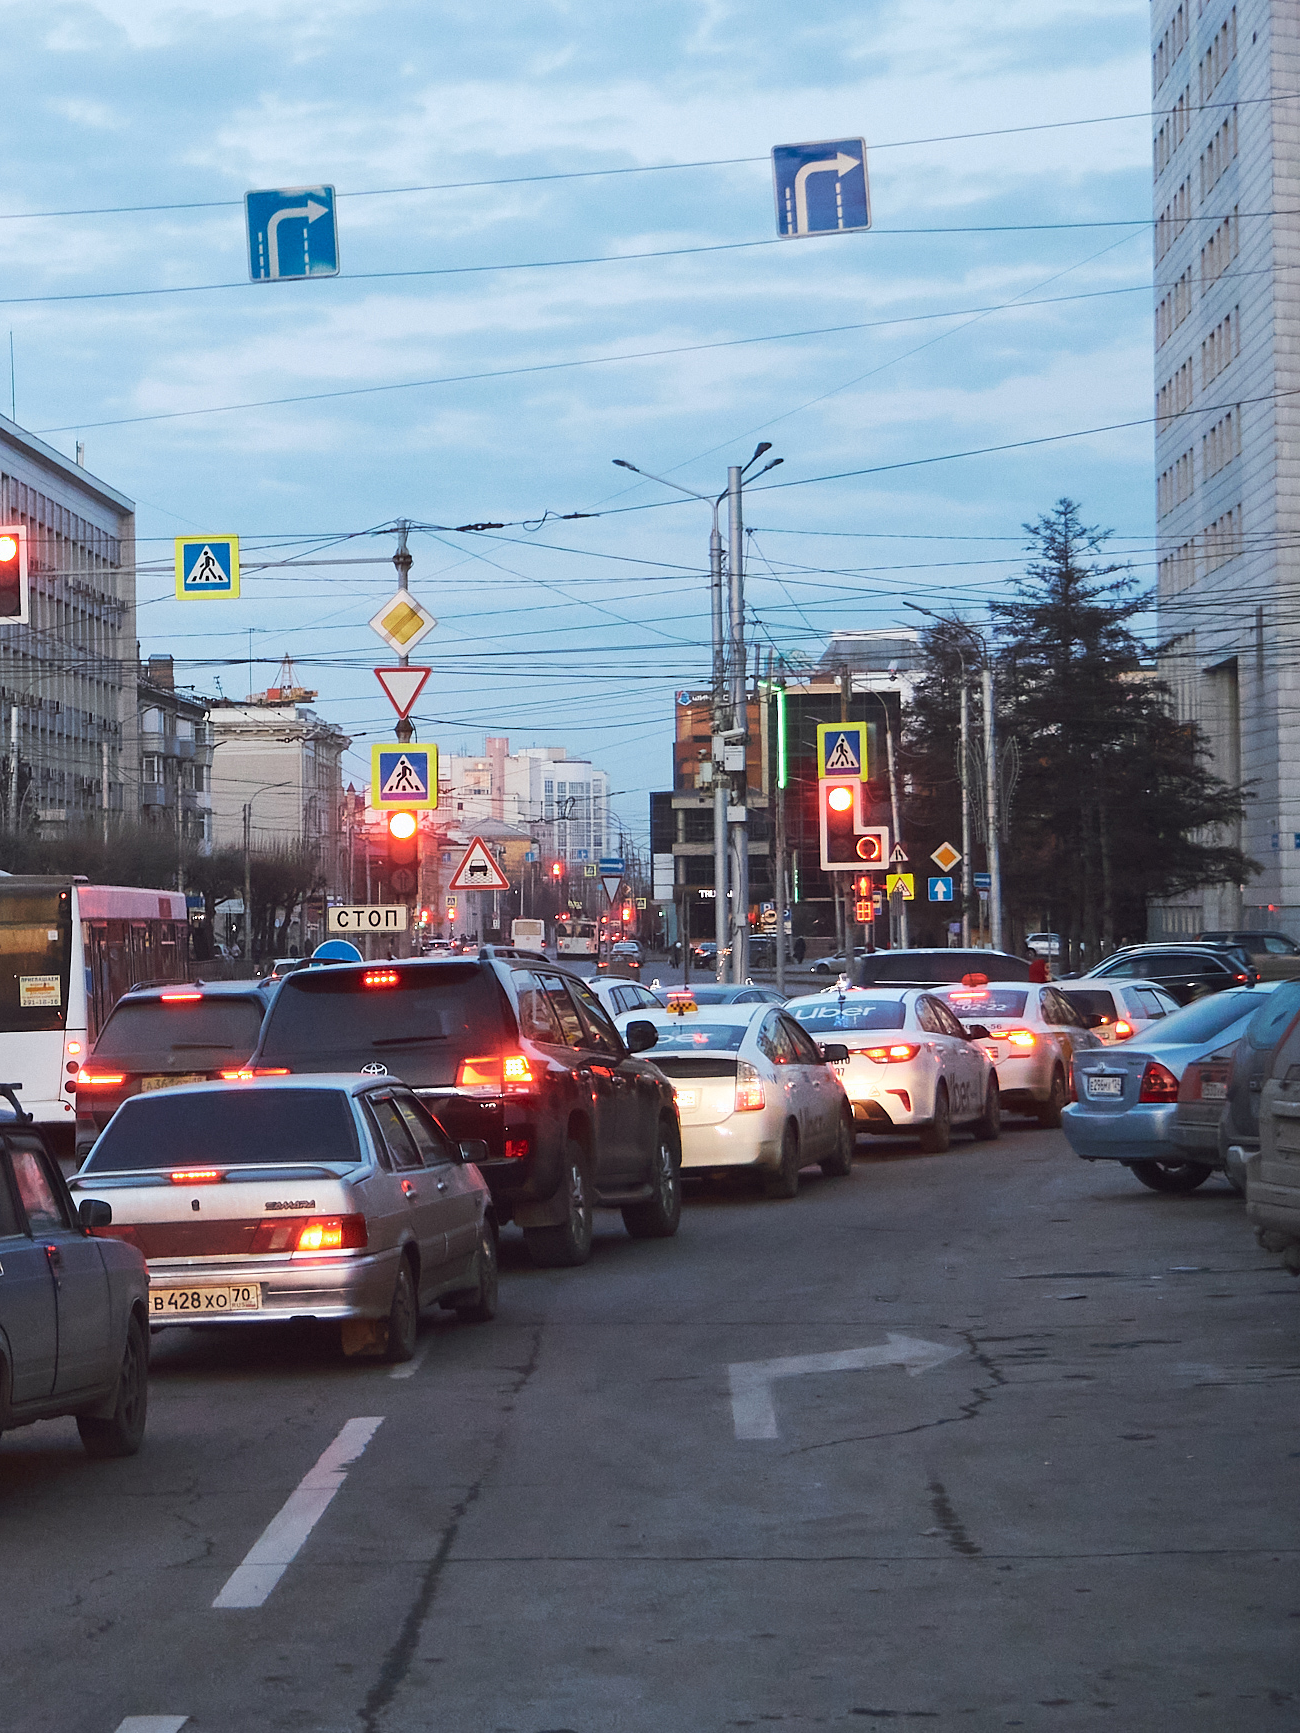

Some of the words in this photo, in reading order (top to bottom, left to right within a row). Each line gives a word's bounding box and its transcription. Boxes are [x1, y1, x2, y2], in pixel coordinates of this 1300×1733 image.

[337, 910, 397, 927] СТОП
[795, 1006, 877, 1020] uber
[154, 1291, 228, 1311] В428ХО
[232, 1288, 251, 1303] 70
